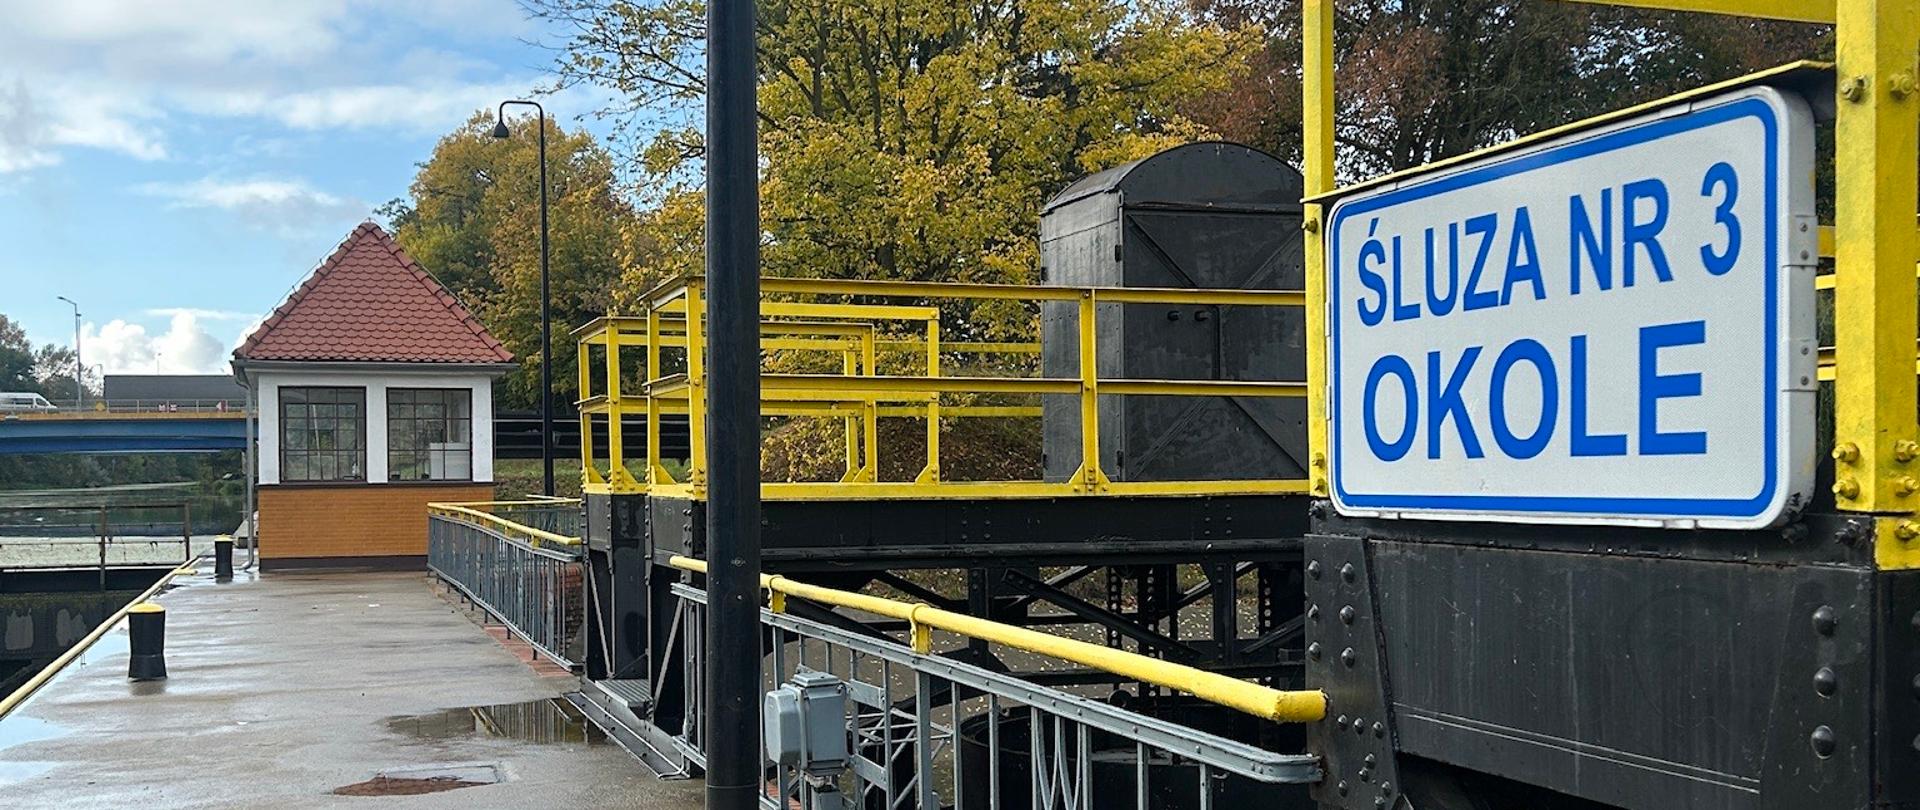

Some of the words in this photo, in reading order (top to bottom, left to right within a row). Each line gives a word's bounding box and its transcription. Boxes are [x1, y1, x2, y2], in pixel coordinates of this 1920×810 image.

[1356, 206, 1547, 328] ŚLUZA
[1569, 178, 1674, 296] NR
[1700, 161, 1743, 277] 3
[1362, 319, 1709, 463] OKOLE
